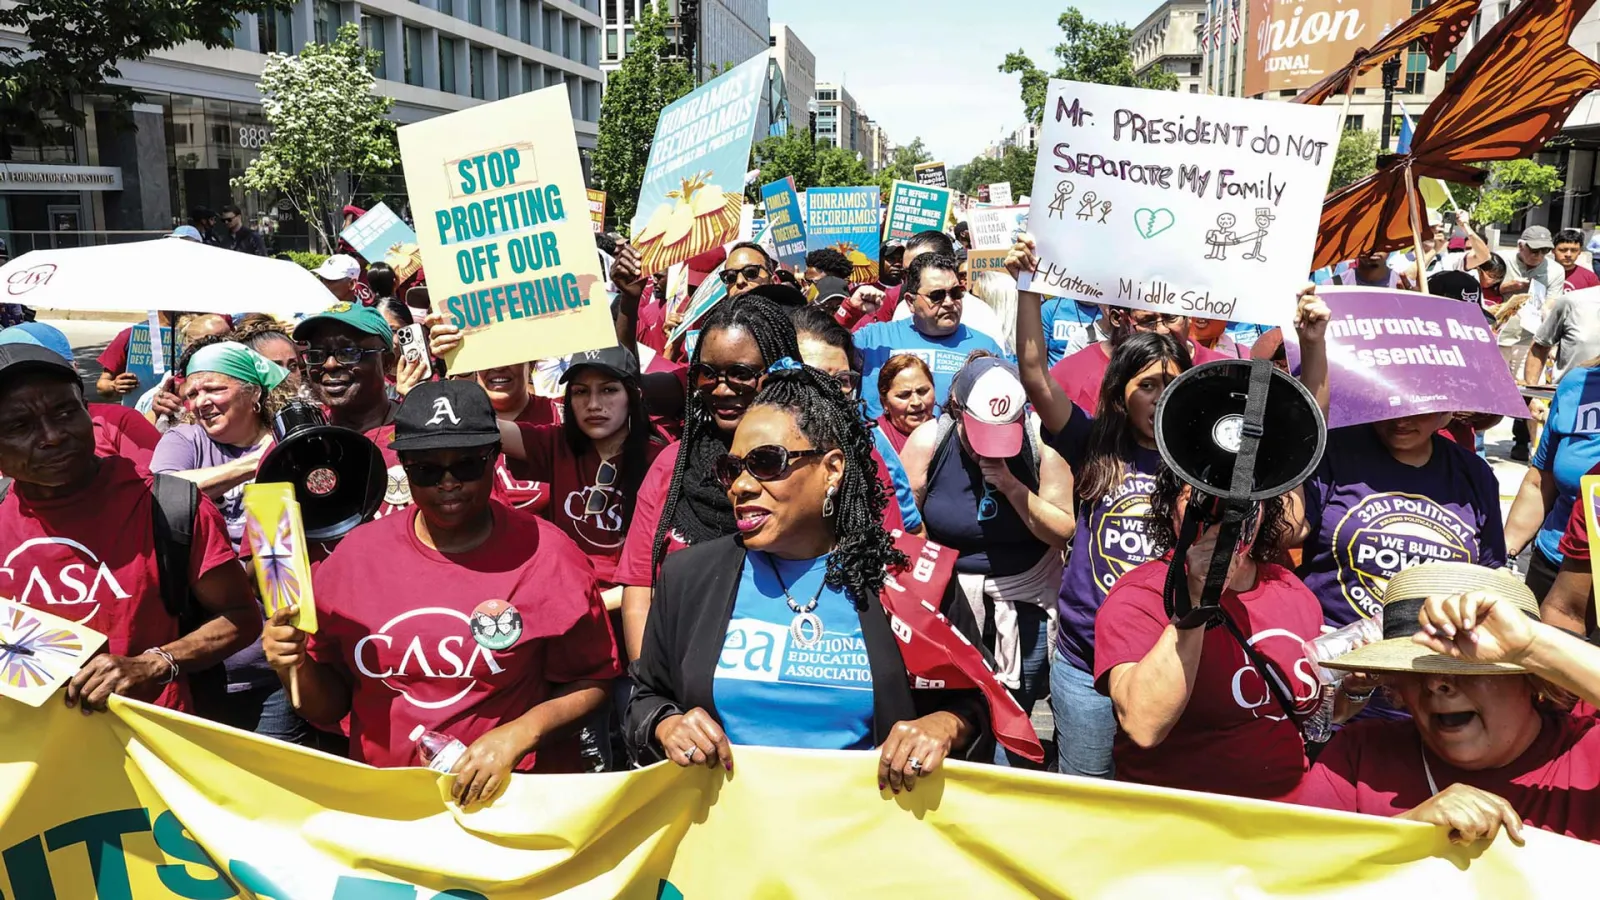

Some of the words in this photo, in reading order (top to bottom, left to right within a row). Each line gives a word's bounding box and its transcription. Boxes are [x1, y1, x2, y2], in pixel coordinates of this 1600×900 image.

[1258, 6, 1365, 61] Union
[658, 77, 742, 139] HONRAMOS
[651, 91, 755, 167] RECORDAMOS
[1055, 95, 1094, 127] Mr.
[1286, 134, 1329, 166] NOT
[458, 147, 520, 195] STOP
[919, 171, 943, 179] Trump
[809, 192, 867, 209] HONRAMOS
[870, 191, 877, 208] Y
[896, 196, 909, 205] LIVE
[909, 198, 916, 207] IN
[898, 187, 908, 196] WE
[908, 188, 930, 200] REFUSE
[930, 192, 938, 201] TO
[435, 183, 565, 246] PROFITING
[810, 209, 877, 226] RECORDAMOS
[893, 212, 905, 222] OUR
[895, 204, 920, 216] COUNTRY
[976, 222, 1007, 235] KILMAR
[978, 234, 1001, 246] HOME
[456, 243, 500, 285] OFF
[507, 231, 561, 274] OUR
[971, 257, 987, 269] LOS
[447, 273, 590, 329] SUFFERING.
[1117, 277, 1176, 305] Middle
[1450, 318, 1491, 343] Are
[130, 354, 144, 365] DES
[425, 396, 461, 426] A
[989, 395, 1010, 417] W
[1122, 518, 1145, 532] WE
[1358, 500, 1392, 523] 32BJ
[1392, 499, 1470, 543] POLITICAL
[1432, 522, 1454, 541] POWER
[1380, 534, 1405, 551] WE
[1409, 541, 1452, 559] BUILD
[718, 628, 775, 673] ea
[787, 651, 870, 666] EDUCATIO
[785, 664, 872, 682] ASSOCIATIO
[0, 807, 240, 900] ITS
